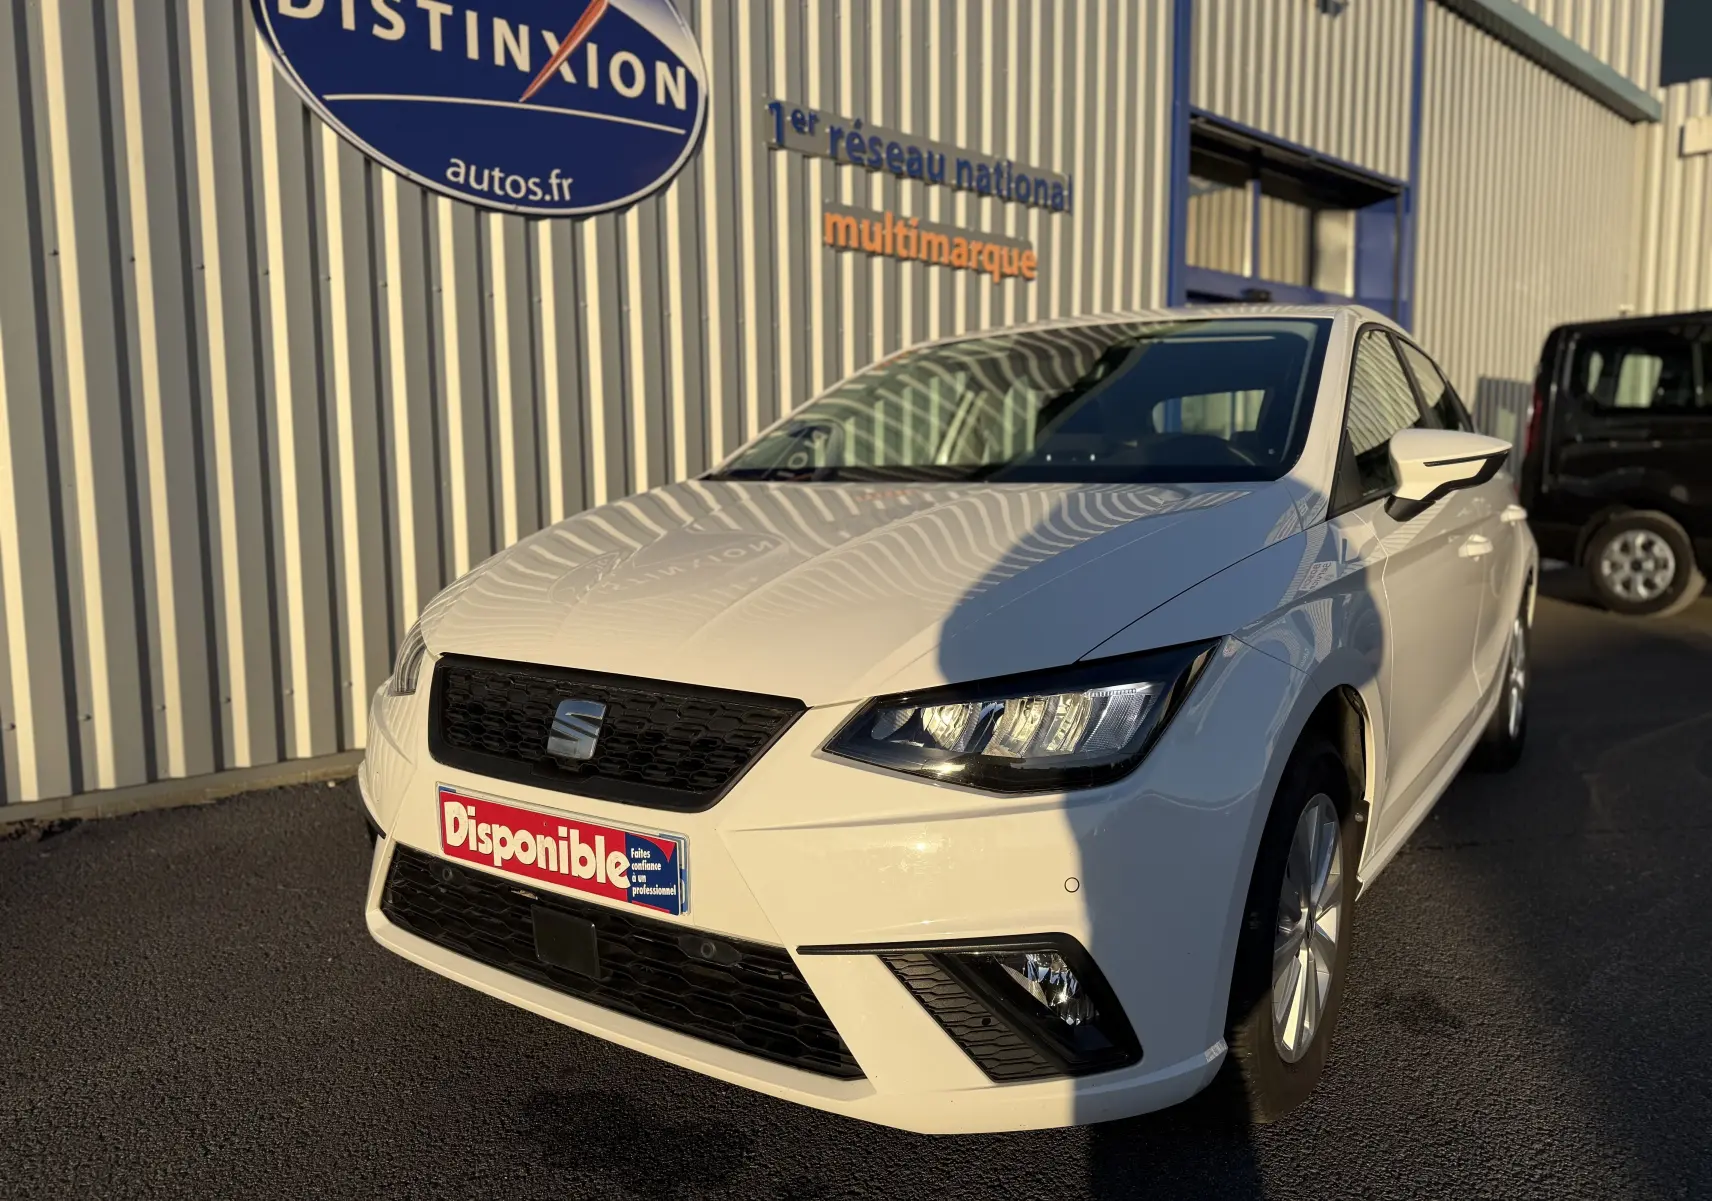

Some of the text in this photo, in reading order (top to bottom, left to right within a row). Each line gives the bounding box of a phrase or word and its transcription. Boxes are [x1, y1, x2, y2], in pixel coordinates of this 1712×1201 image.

[768, 101, 1073, 215] 1er réseau national
[446, 158, 573, 201] autos.fr
[824, 211, 1038, 283] multimarque
[443, 801, 631, 889] Disponible
[630, 848, 651, 858] Faites
[631, 860, 662, 870] confiance
[631, 872, 637, 882] à
[632, 884, 677, 897] professionnel
